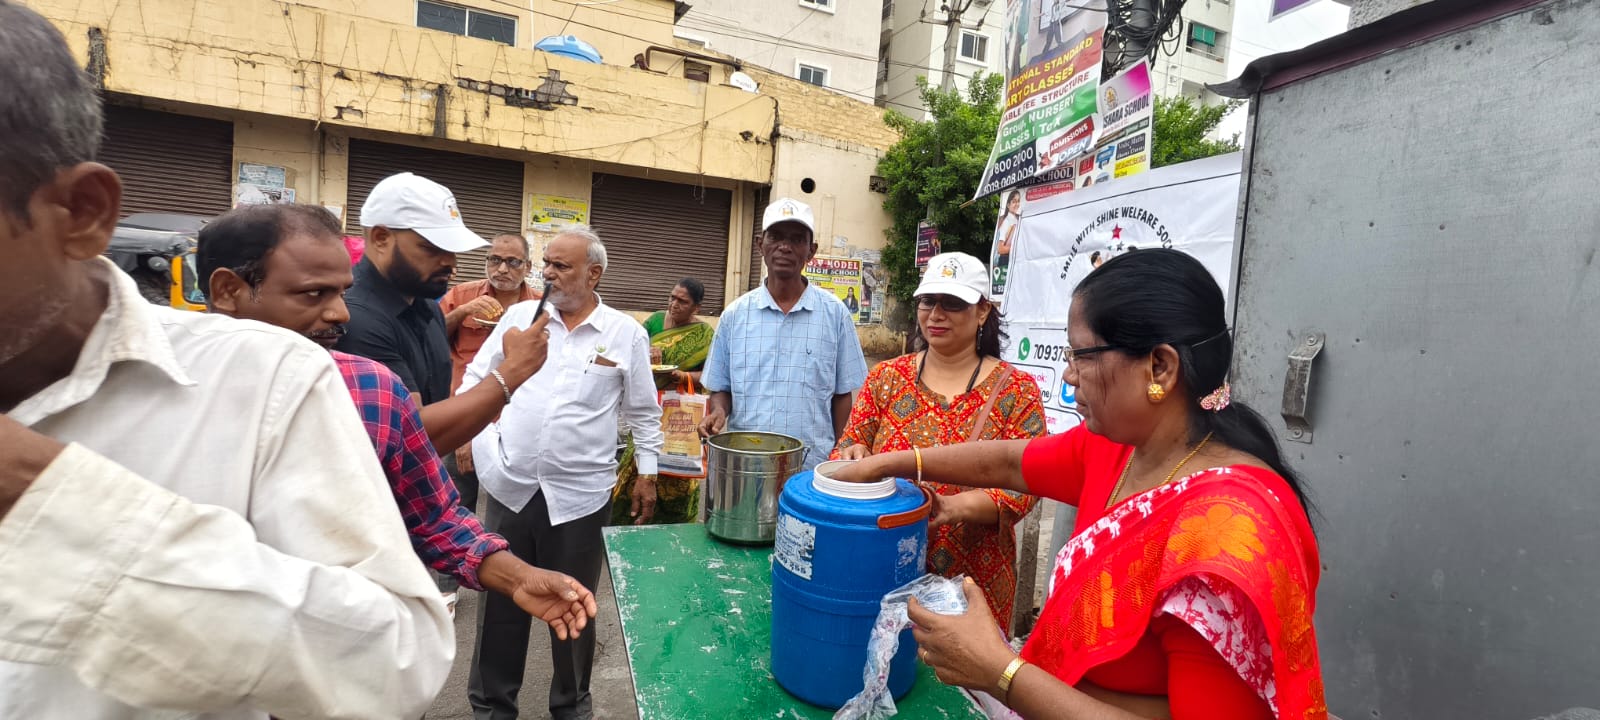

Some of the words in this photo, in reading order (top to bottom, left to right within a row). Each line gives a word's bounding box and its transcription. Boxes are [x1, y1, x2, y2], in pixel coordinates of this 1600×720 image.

[1044, 37, 1093, 71] STANDARD
[1024, 64, 1074, 96] CLASSES
[1042, 72, 1089, 103] STRUCTURE
[1029, 94, 1075, 123] NURSERY
[1103, 108, 1123, 128] SHARA
[1124, 93, 1149, 117] SCHOOL
[1050, 123, 1089, 153] ADMISSIONS
[1060, 137, 1088, 162] OPEN
[1060, 244, 1078, 281] SMILE
[1075, 221, 1096, 245] WITH
[1096, 207, 1119, 227] SHINE
[1121, 206, 1159, 230] WELFARE
[806, 266, 828, 275] HIGH
[831, 268, 858, 277] SCHOOL
